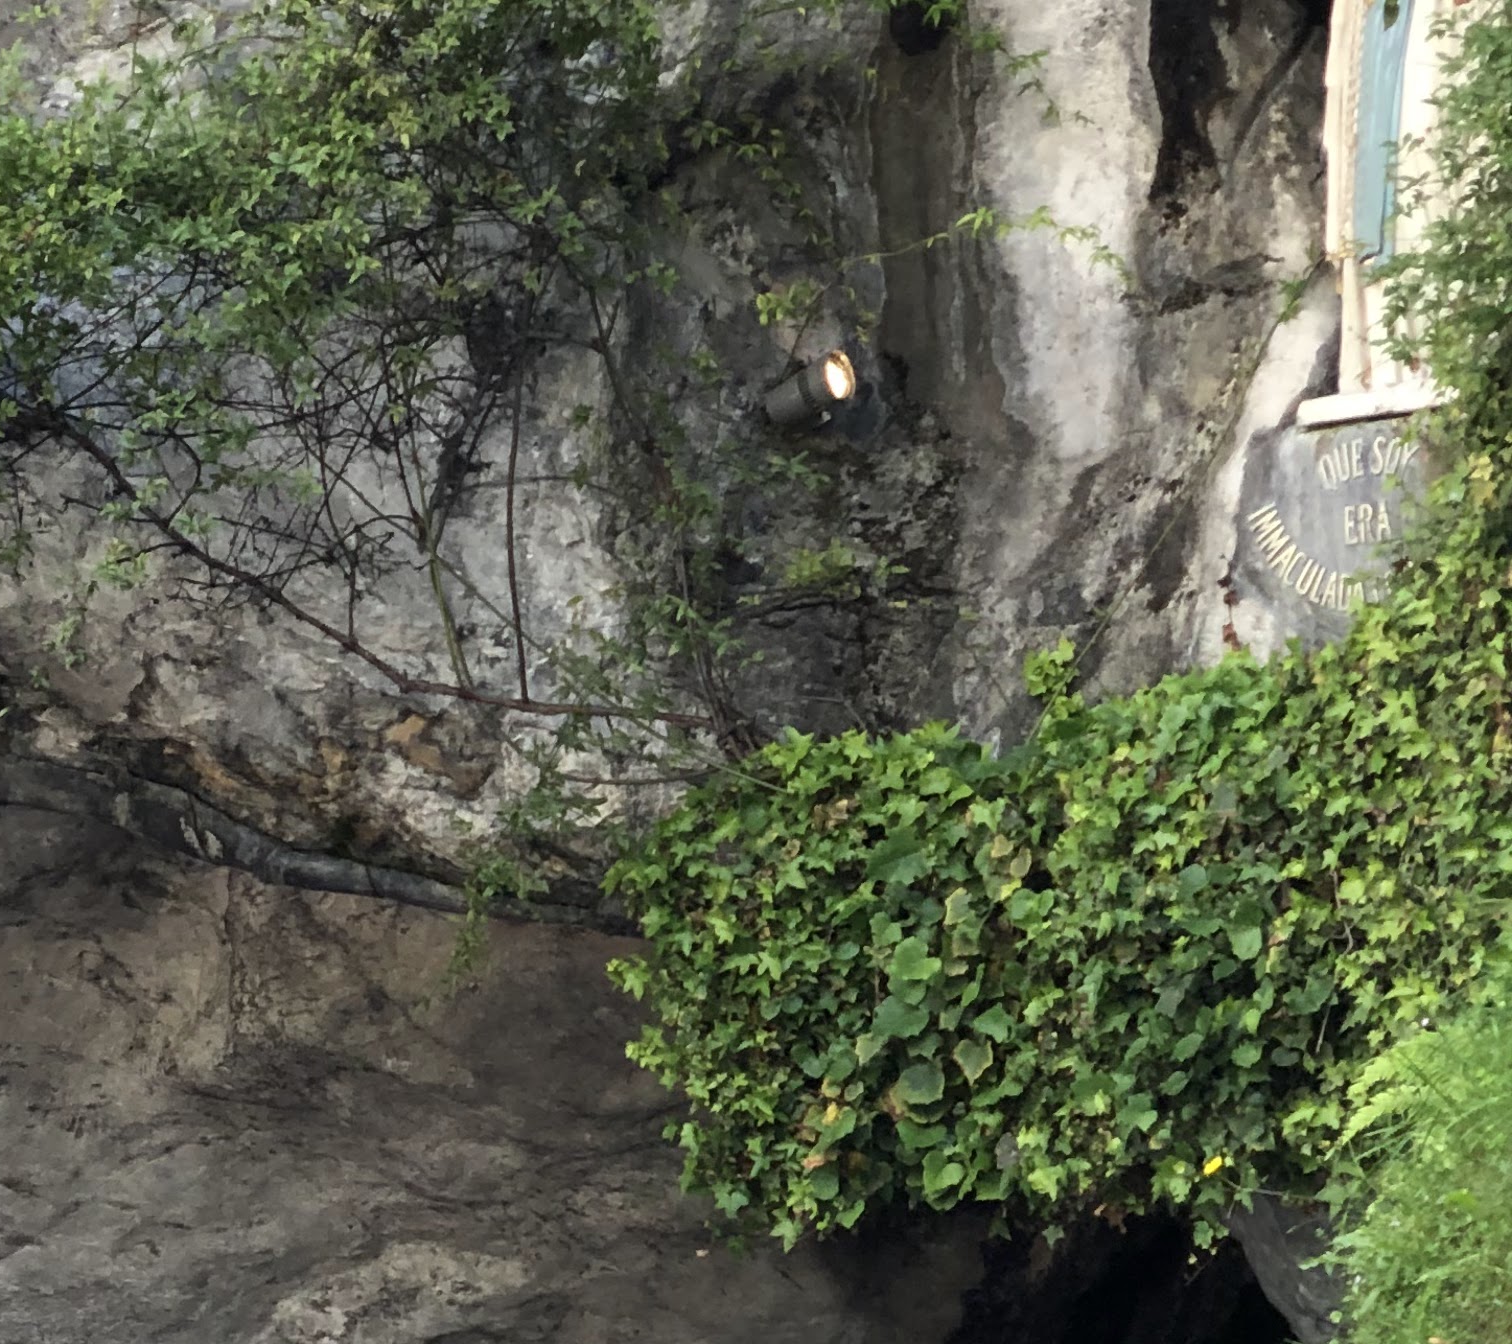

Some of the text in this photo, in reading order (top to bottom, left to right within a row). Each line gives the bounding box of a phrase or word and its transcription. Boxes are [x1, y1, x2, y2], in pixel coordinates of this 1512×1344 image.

[1319, 436, 1420, 490] QUE SOY
[1344, 500, 1391, 544] ERA
